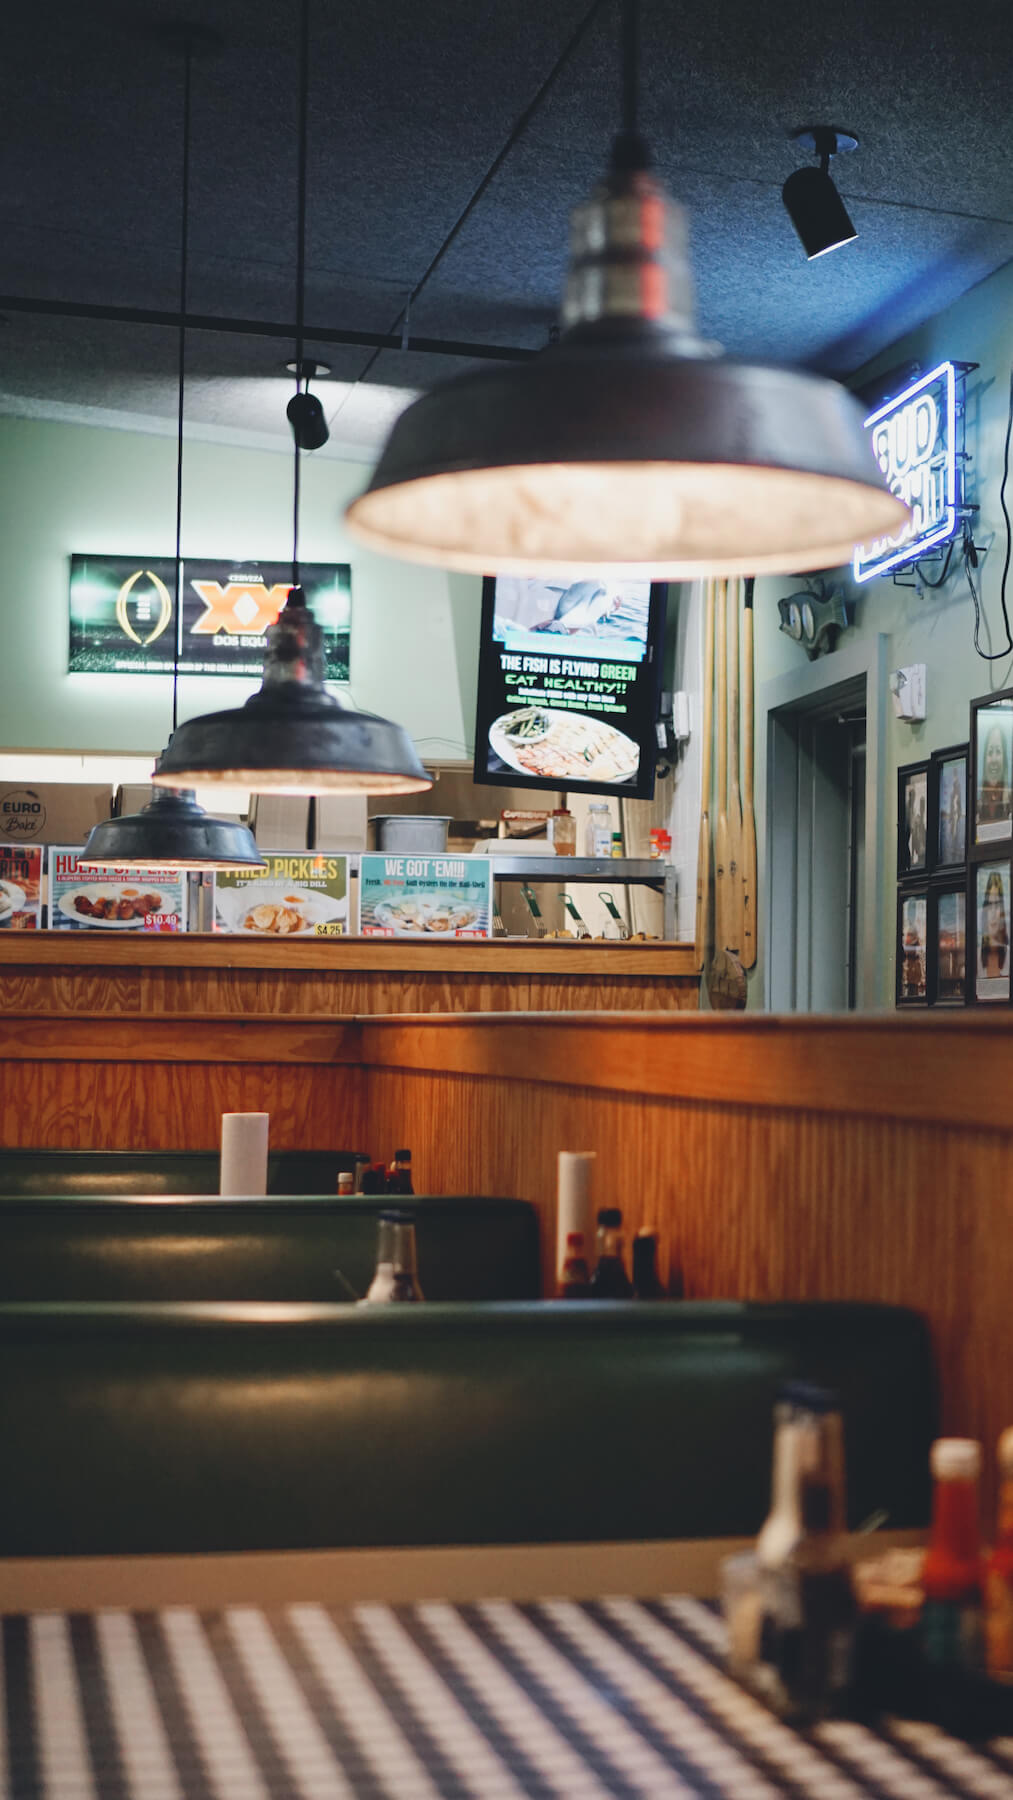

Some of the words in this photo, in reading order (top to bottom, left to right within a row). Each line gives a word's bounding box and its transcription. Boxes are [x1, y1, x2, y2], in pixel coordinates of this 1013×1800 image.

[228, 574, 264, 583] CERVEZA
[213, 635, 239, 646] DOS
[240, 637, 267, 647] EQU
[500, 654, 522, 671] THE
[523, 656, 548, 674] FISH
[549, 658, 561, 675] IS
[562, 660, 600, 678] FLYING
[600, 663, 637, 681] GREEN
[505, 674, 538, 687] EAT
[544, 677, 627, 694] HEALTHY!!
[3, 802, 41, 813] EURO
[5, 817, 37, 832] Bake
[274, 858, 337, 879] PICKLES
[385, 860, 404, 876] WE
[406, 860, 430, 877] GOT
[295, 880, 309, 888] BIG
[310, 880, 328, 888] DILL
[146, 915, 177, 926] $10.49
[317, 924, 341, 936] $425
